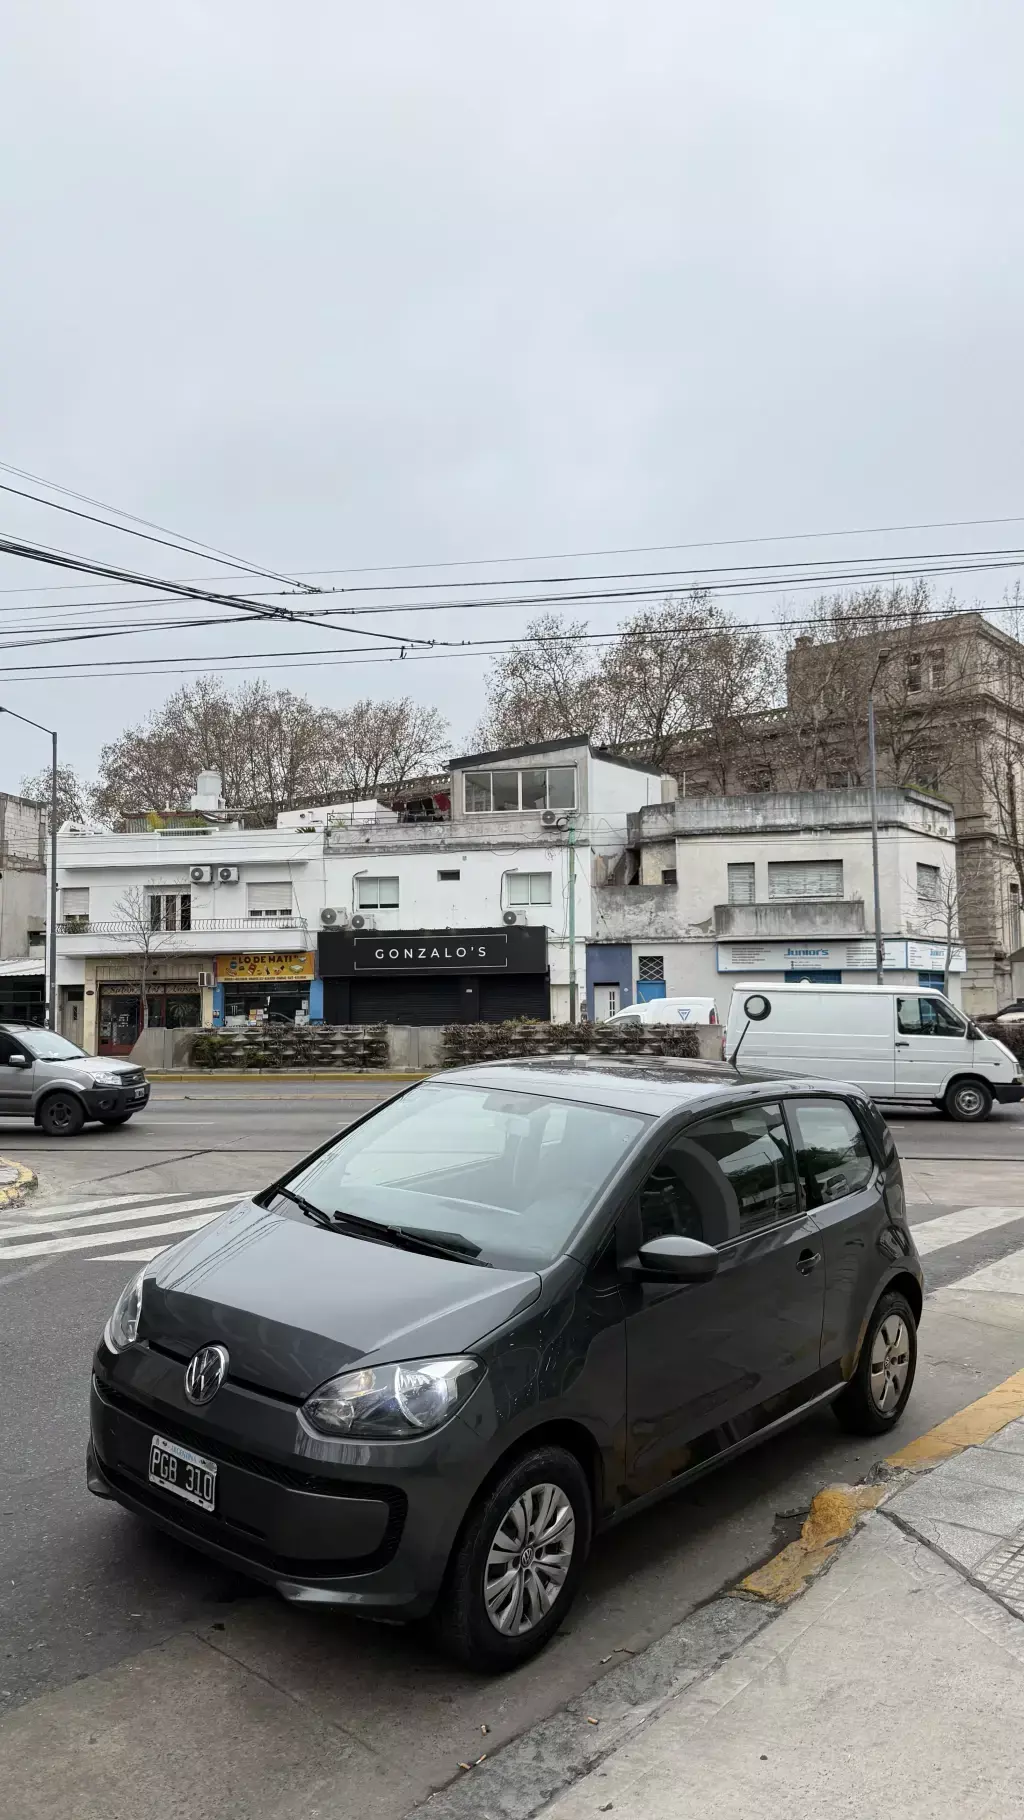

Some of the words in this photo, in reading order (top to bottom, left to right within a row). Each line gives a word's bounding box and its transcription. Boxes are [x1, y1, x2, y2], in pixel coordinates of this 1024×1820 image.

[375, 946, 486, 959] GONZALO'S
[253, 956, 266, 964] DE
[151, 1448, 177, 1482] PGB
[185, 1465, 212, 1501] 310
